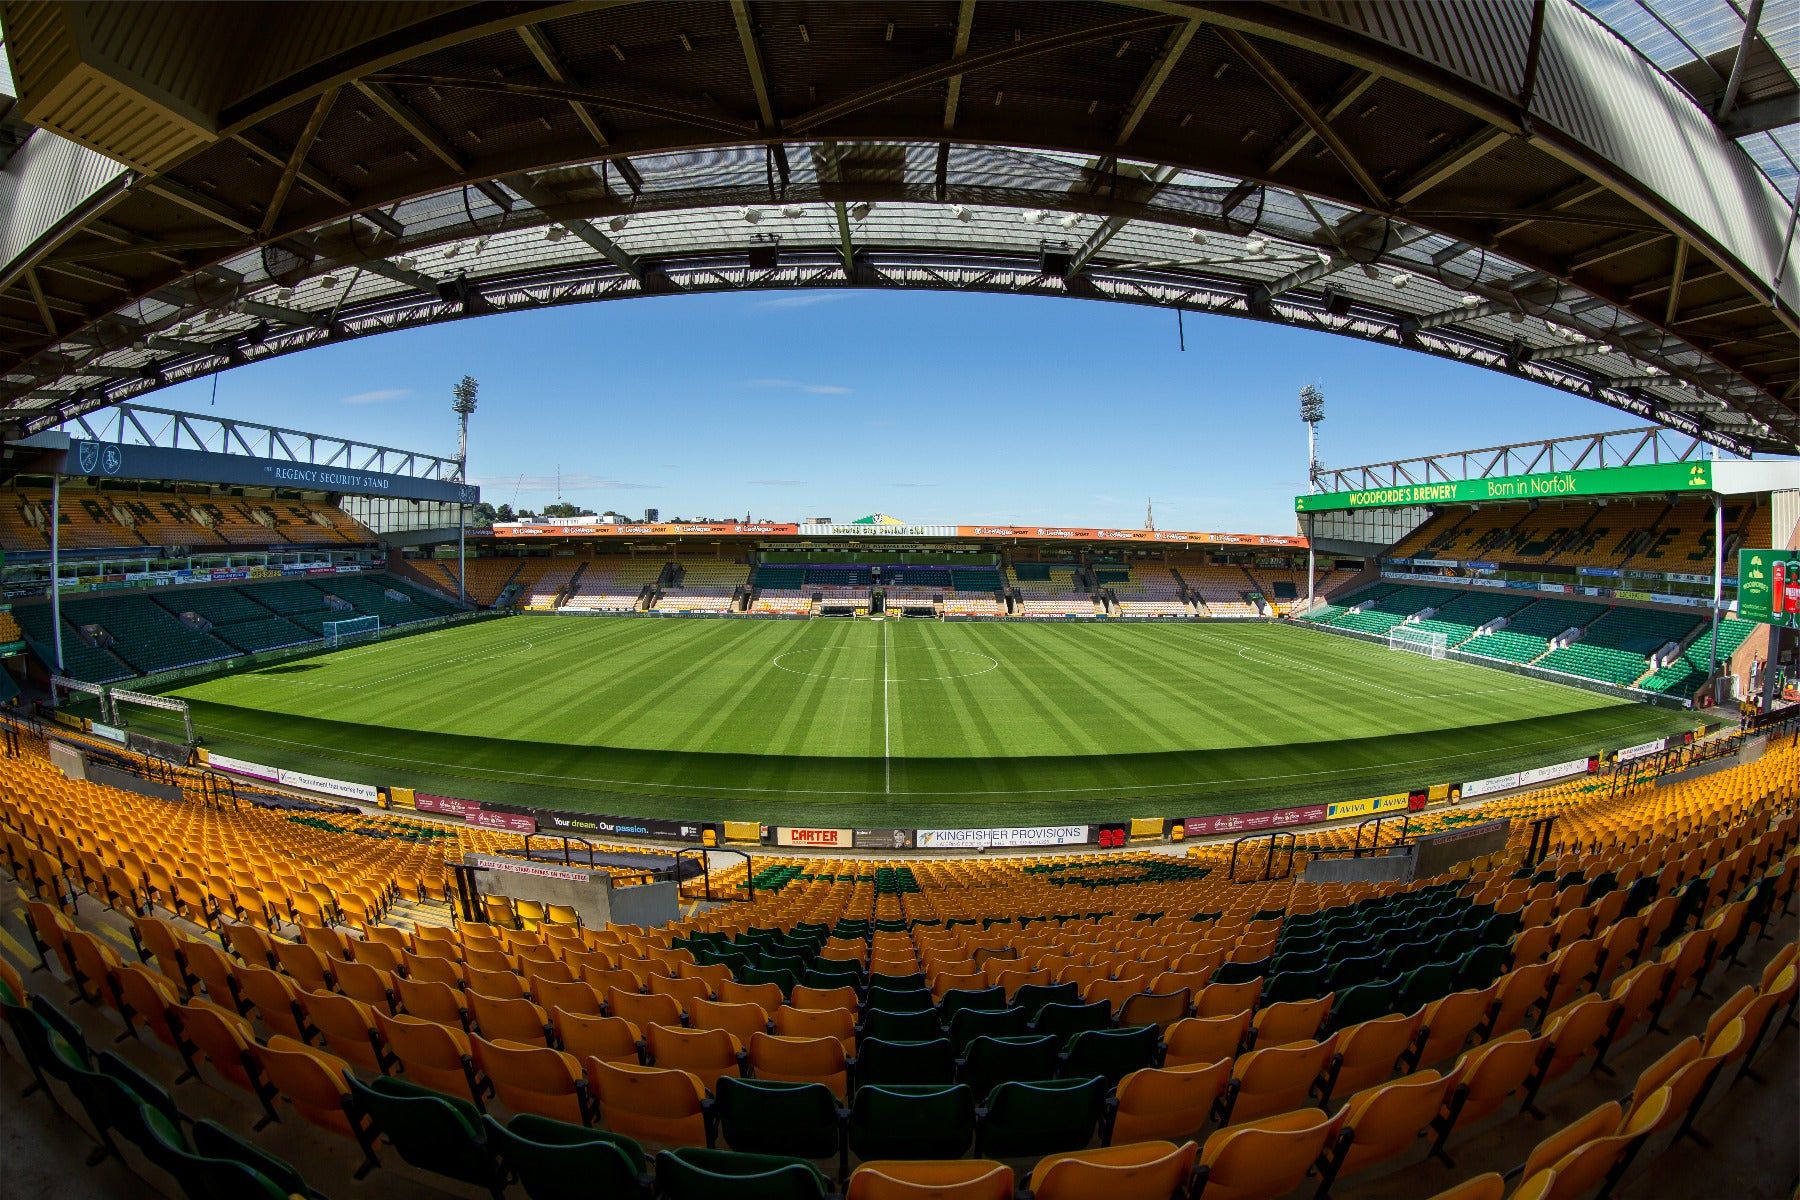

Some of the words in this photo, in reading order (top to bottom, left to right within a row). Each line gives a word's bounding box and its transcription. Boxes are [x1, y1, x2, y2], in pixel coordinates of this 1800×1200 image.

[275, 467, 317, 482] REGENCY
[320, 472, 362, 486] SECURITY
[363, 477, 389, 489] STAND
[1349, 489, 1411, 506] WOODFORDE'S
[1413, 485, 1457, 502] BREWERY
[1488, 481, 1515, 496] Born
[1517, 480, 1528, 494] in
[1531, 476, 1577, 494] Norfolk
[863, 528, 876, 536] City
[1339, 803, 1366, 814] AVIVA
[1382, 797, 1406, 807] AVIVA
[553, 817, 570, 827] Your
[571, 819, 598, 829] dream.
[599, 822, 614, 831] Our
[615, 825, 649, 835] passion.
[791, 829, 837, 841] CARTER
[935, 830, 1008, 841] KINGFISHER
[1011, 827, 1081, 839] PROVISIONS
